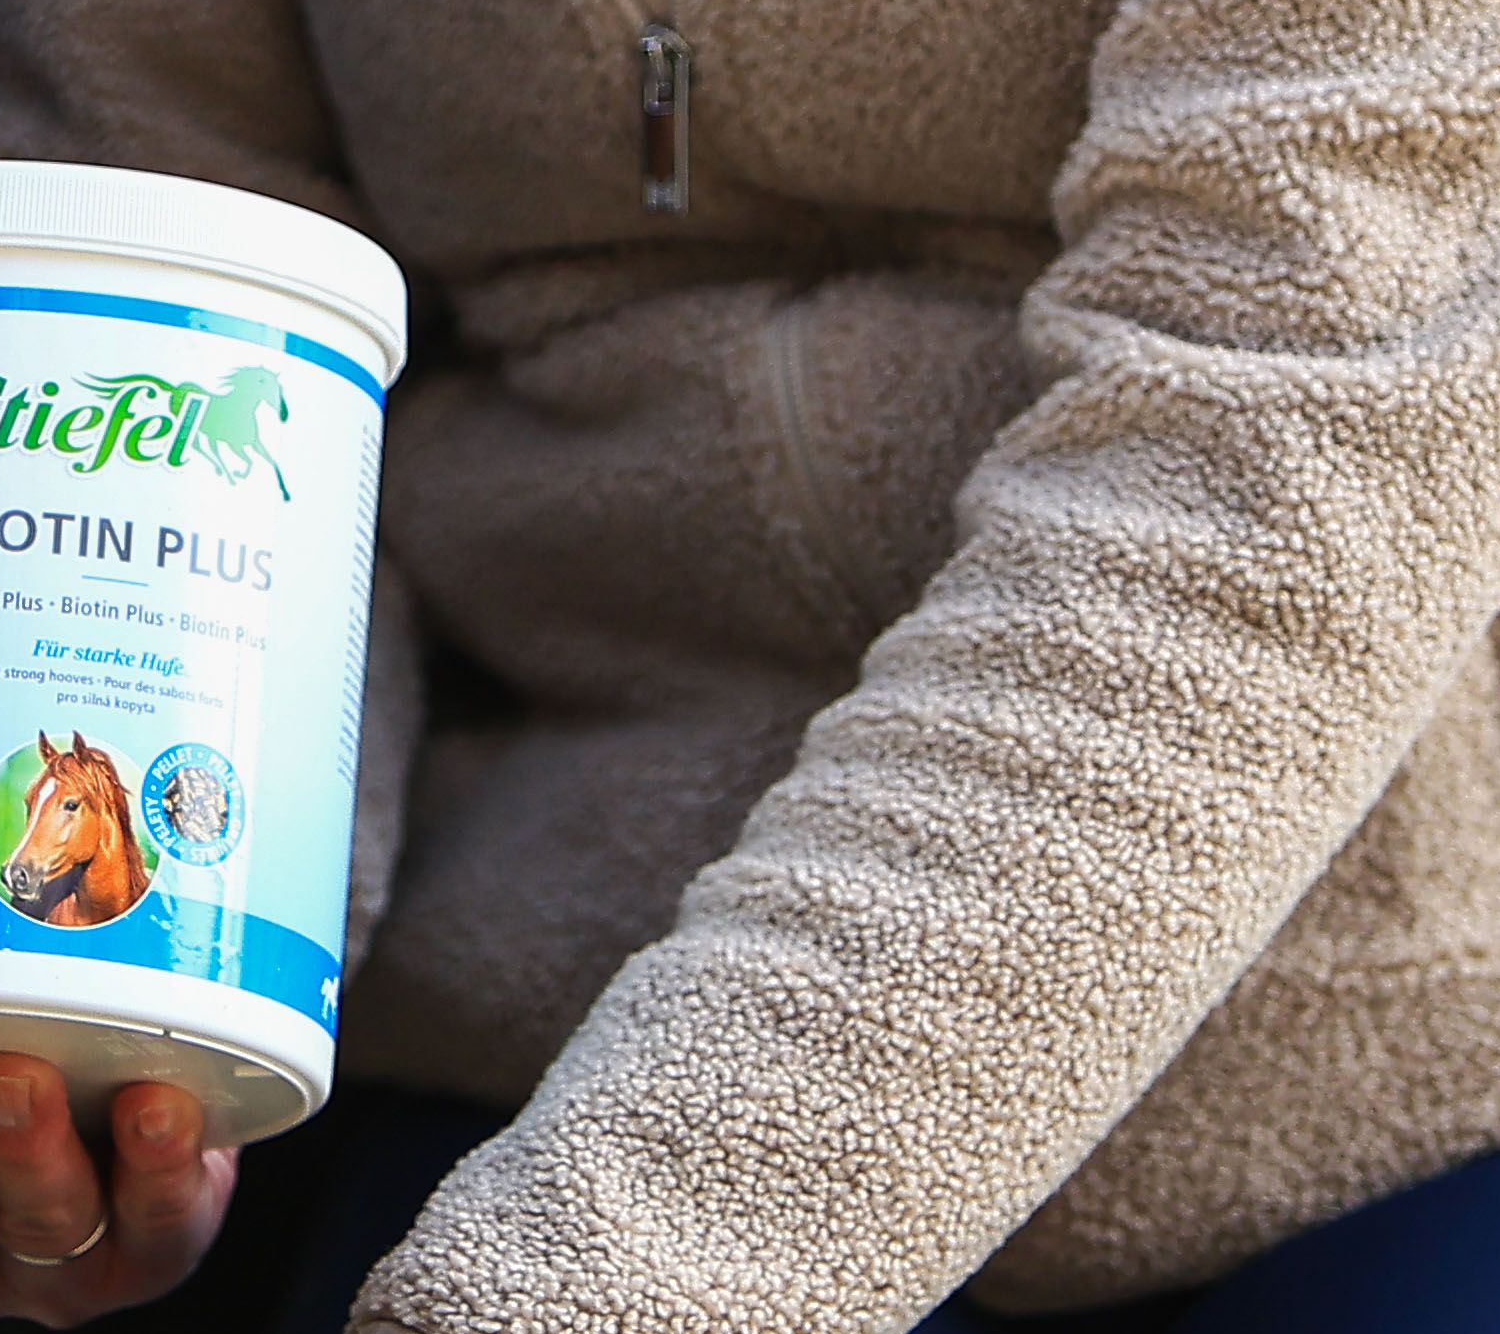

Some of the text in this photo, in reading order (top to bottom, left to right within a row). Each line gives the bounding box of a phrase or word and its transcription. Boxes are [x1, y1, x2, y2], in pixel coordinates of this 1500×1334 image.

[156, 526, 273, 591] PLUS
[3, 592, 44, 612] Plus
[61, 597, 119, 620] Biotin
[126, 604, 164, 627] Plus
[180, 612, 230, 641] Biotin
[235, 625, 268, 652] Plus
[32, 638, 186, 677] Für starke Hufe
[4, 667, 45, 684] strong
[50, 669, 94, 685] hooves
[104, 676, 131, 691] Pour
[135, 679, 156, 694] des
[56, 692, 79, 706] pro
[114, 696, 156, 713] kopyta
